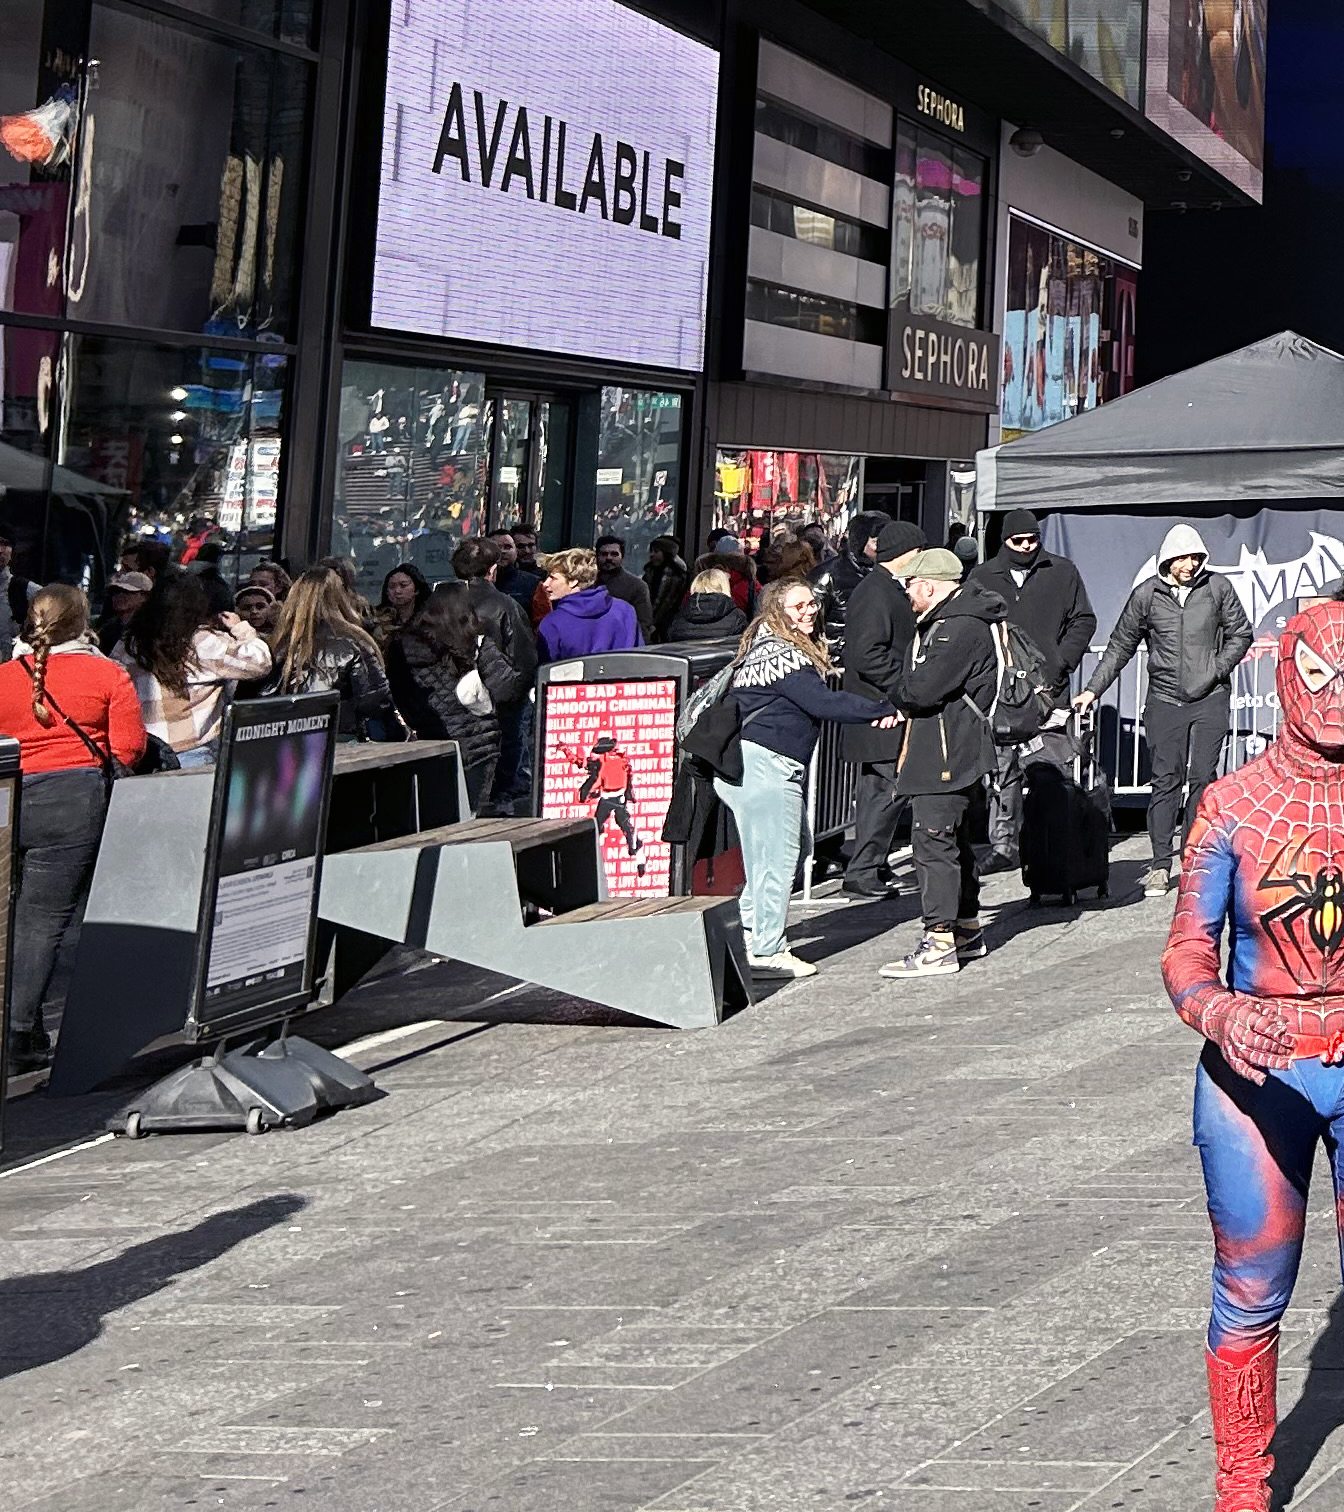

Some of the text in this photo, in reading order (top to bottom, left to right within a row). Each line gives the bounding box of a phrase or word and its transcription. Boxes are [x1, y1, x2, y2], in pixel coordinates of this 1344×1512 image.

[917, 84, 966, 133] SEPHORA
[432, 82, 686, 240] AVAILABLE
[902, 325, 990, 391] SEPHORA
[547, 681, 675, 700] JAM BAD MONEY
[548, 697, 675, 715] SMOOTH CRIMINAL
[287, 714, 331, 732] MOMENT
[548, 717, 574, 730] BILLIE
[577, 716, 600, 729] JEAN
[615, 714, 636, 727] WANT
[547, 731, 580, 744] BLAME
[584, 730, 594, 743] IT
[616, 729, 636, 741] THE
[638, 728, 675, 740] BOOGIE
[659, 742, 674, 754] IT
[661, 757, 673, 769] US
[545, 772, 672, 789] DANC CHINE
[545, 792, 574, 804] MAN
[607, 844, 671, 859] NAURE
